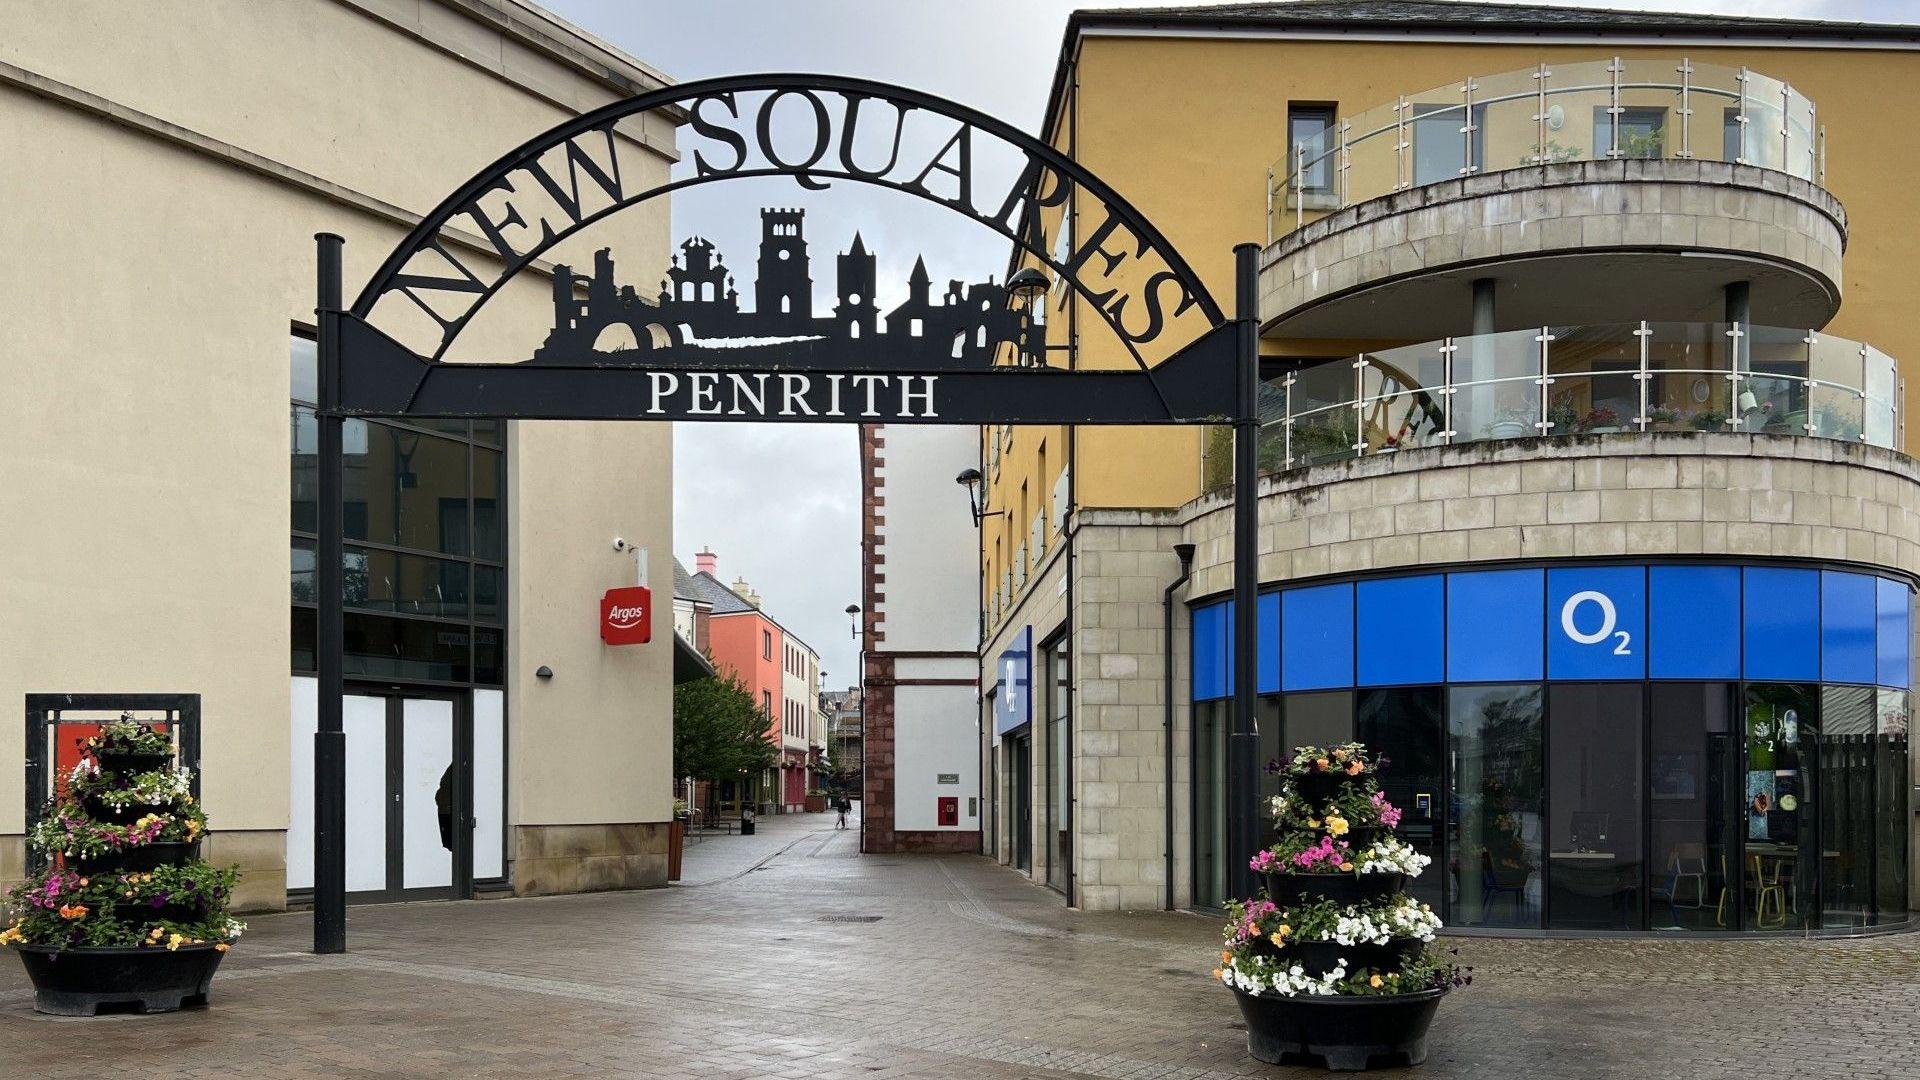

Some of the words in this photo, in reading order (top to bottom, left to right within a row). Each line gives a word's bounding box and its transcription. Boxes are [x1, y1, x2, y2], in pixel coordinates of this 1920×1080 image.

[379, 120, 624, 344] NEW
[689, 88, 1201, 344] SQUARES
[646, 371, 939, 417] PENRITH
[608, 605, 643, 623] Argos
[1561, 590, 1632, 656] O2
